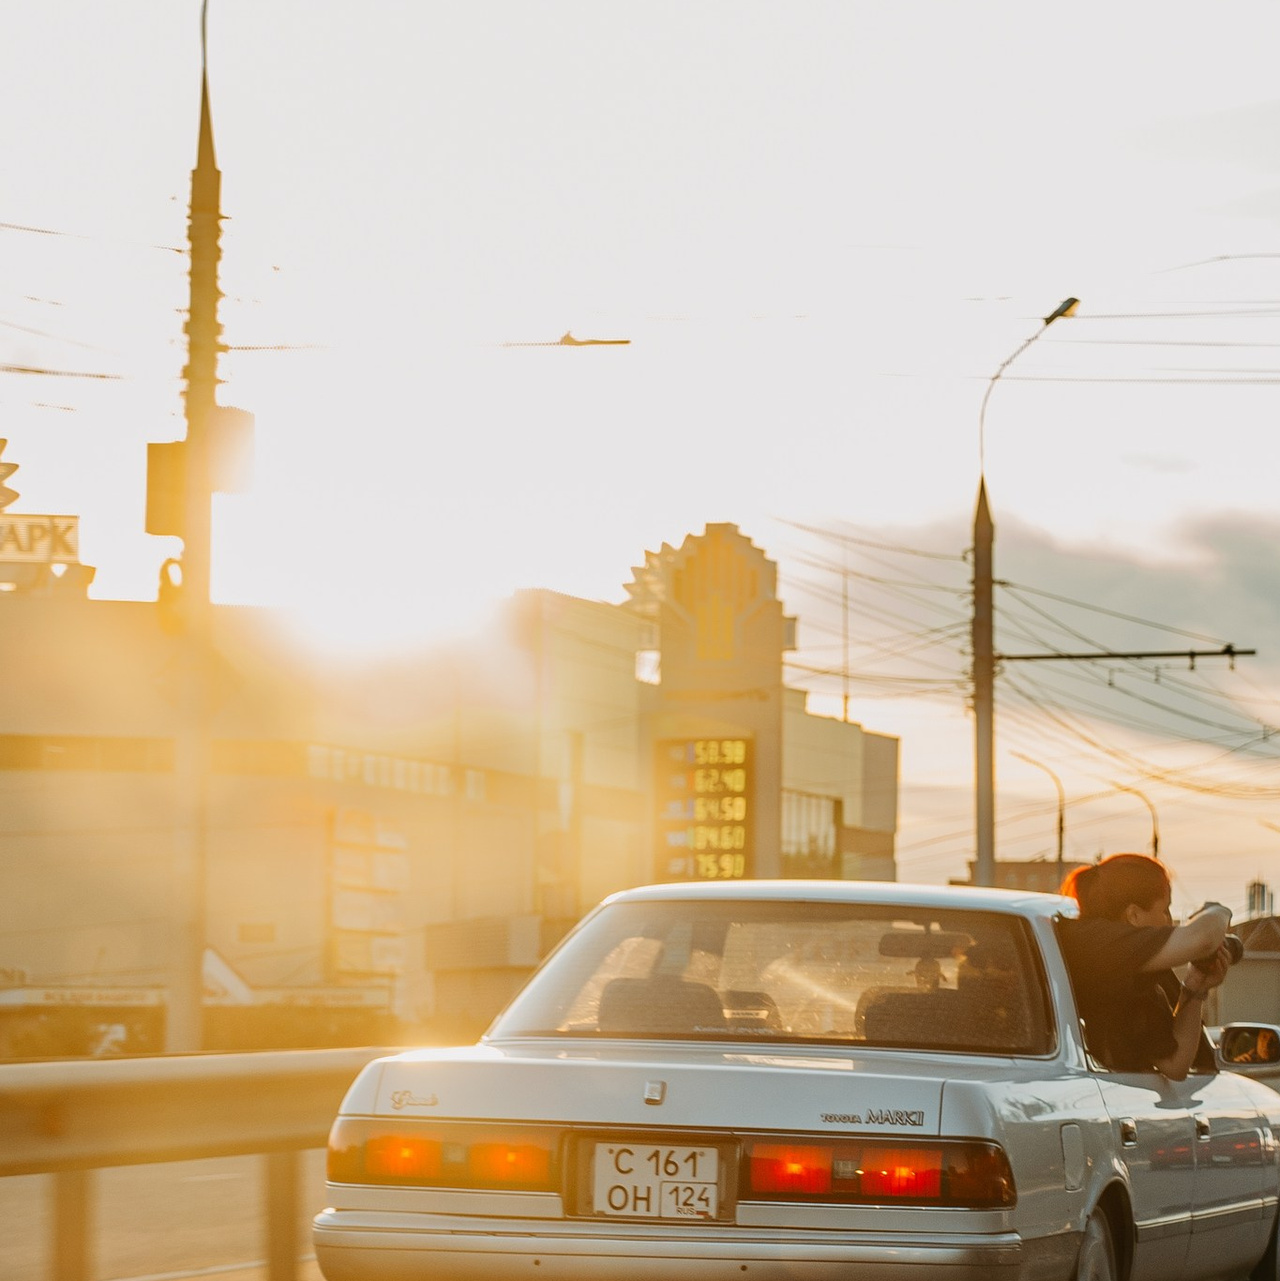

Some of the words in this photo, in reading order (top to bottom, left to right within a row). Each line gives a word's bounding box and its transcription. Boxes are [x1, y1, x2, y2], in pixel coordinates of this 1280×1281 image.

[647, 1150, 698, 1178] 161
[669, 1186, 710, 1208] 124
[676, 1206, 697, 1216] RUS
